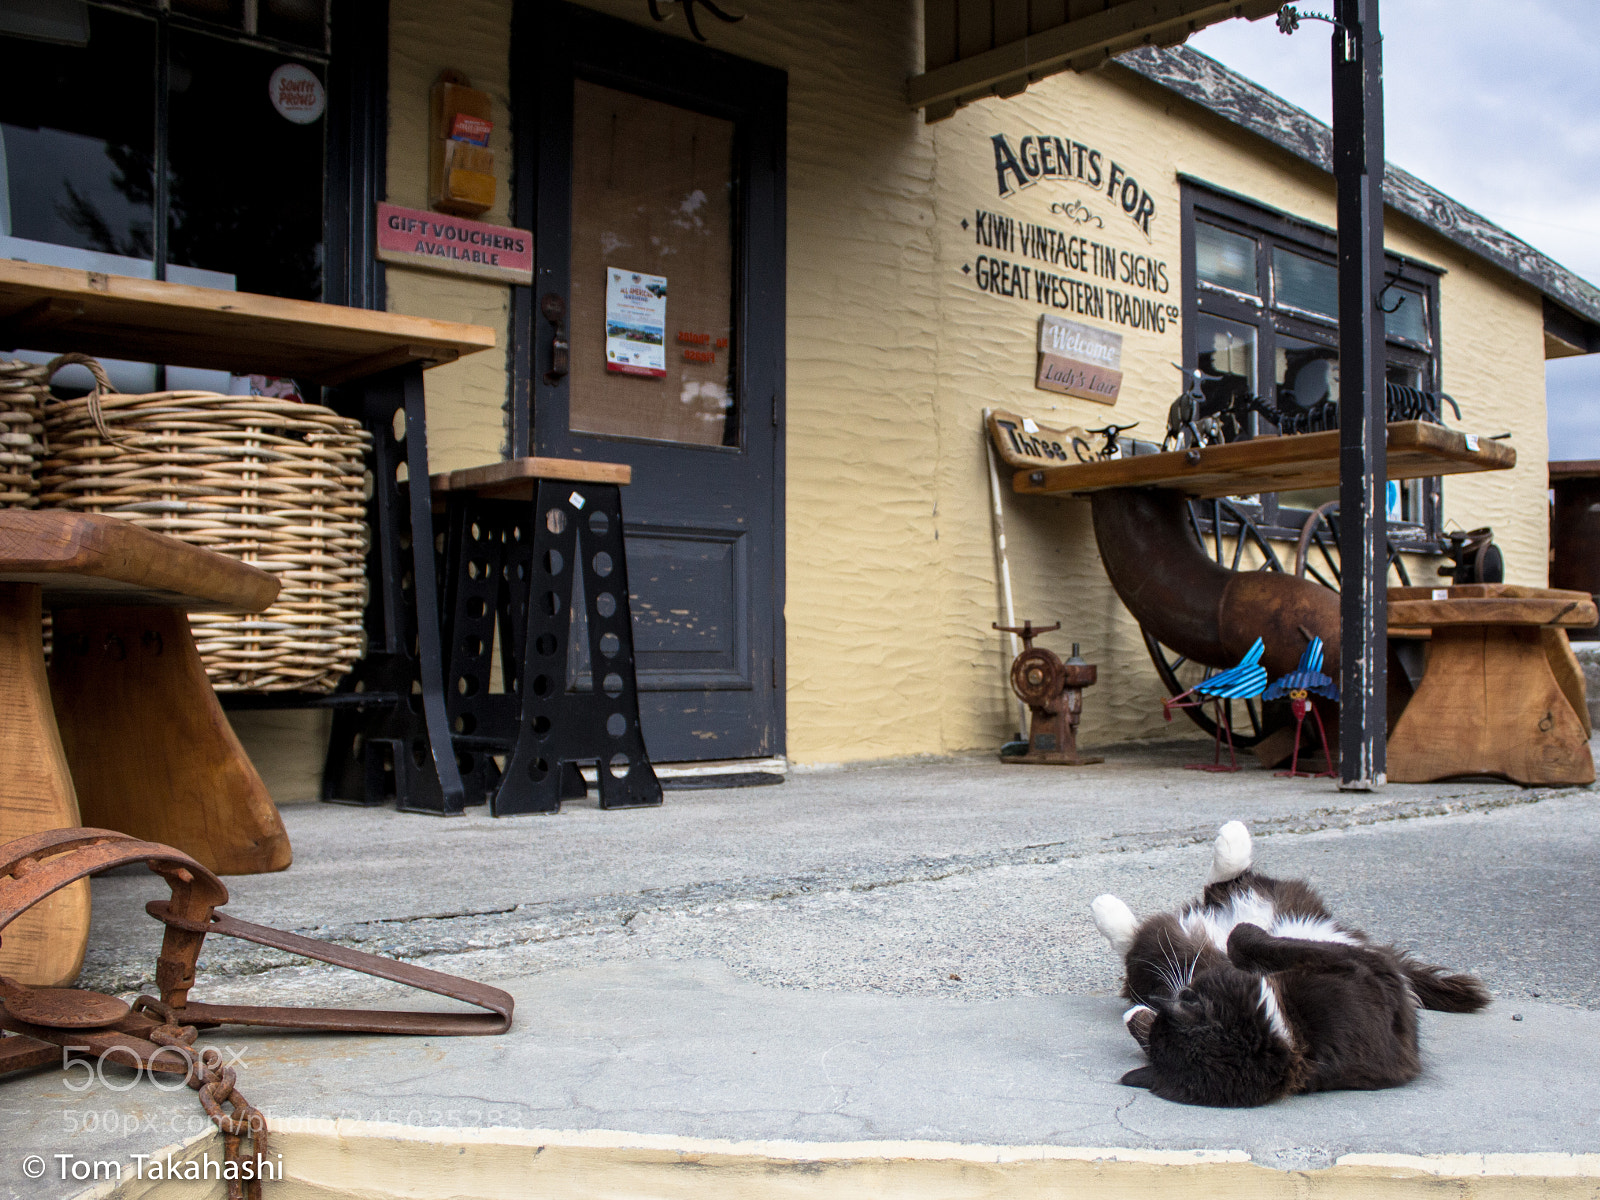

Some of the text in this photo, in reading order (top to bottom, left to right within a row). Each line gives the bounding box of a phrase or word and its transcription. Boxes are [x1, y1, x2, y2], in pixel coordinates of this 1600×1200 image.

[279, 92, 316, 106] PROUD
[991, 133, 1156, 241] AGENTS FOR
[388, 215, 525, 253] GIFT VOUCHERS
[975, 209, 1170, 294] KIWI VINTAGE TIN SIGNS
[414, 240, 499, 267] AVAILABLE
[975, 254, 1031, 300] GREAT
[1034, 269, 1104, 319] WESTERN
[1106, 289, 1166, 334] TRADING
[1049, 325, 1116, 361] Welcome
[1045, 363, 1118, 396] Lady's Lair
[997, 419, 1068, 462] Three
